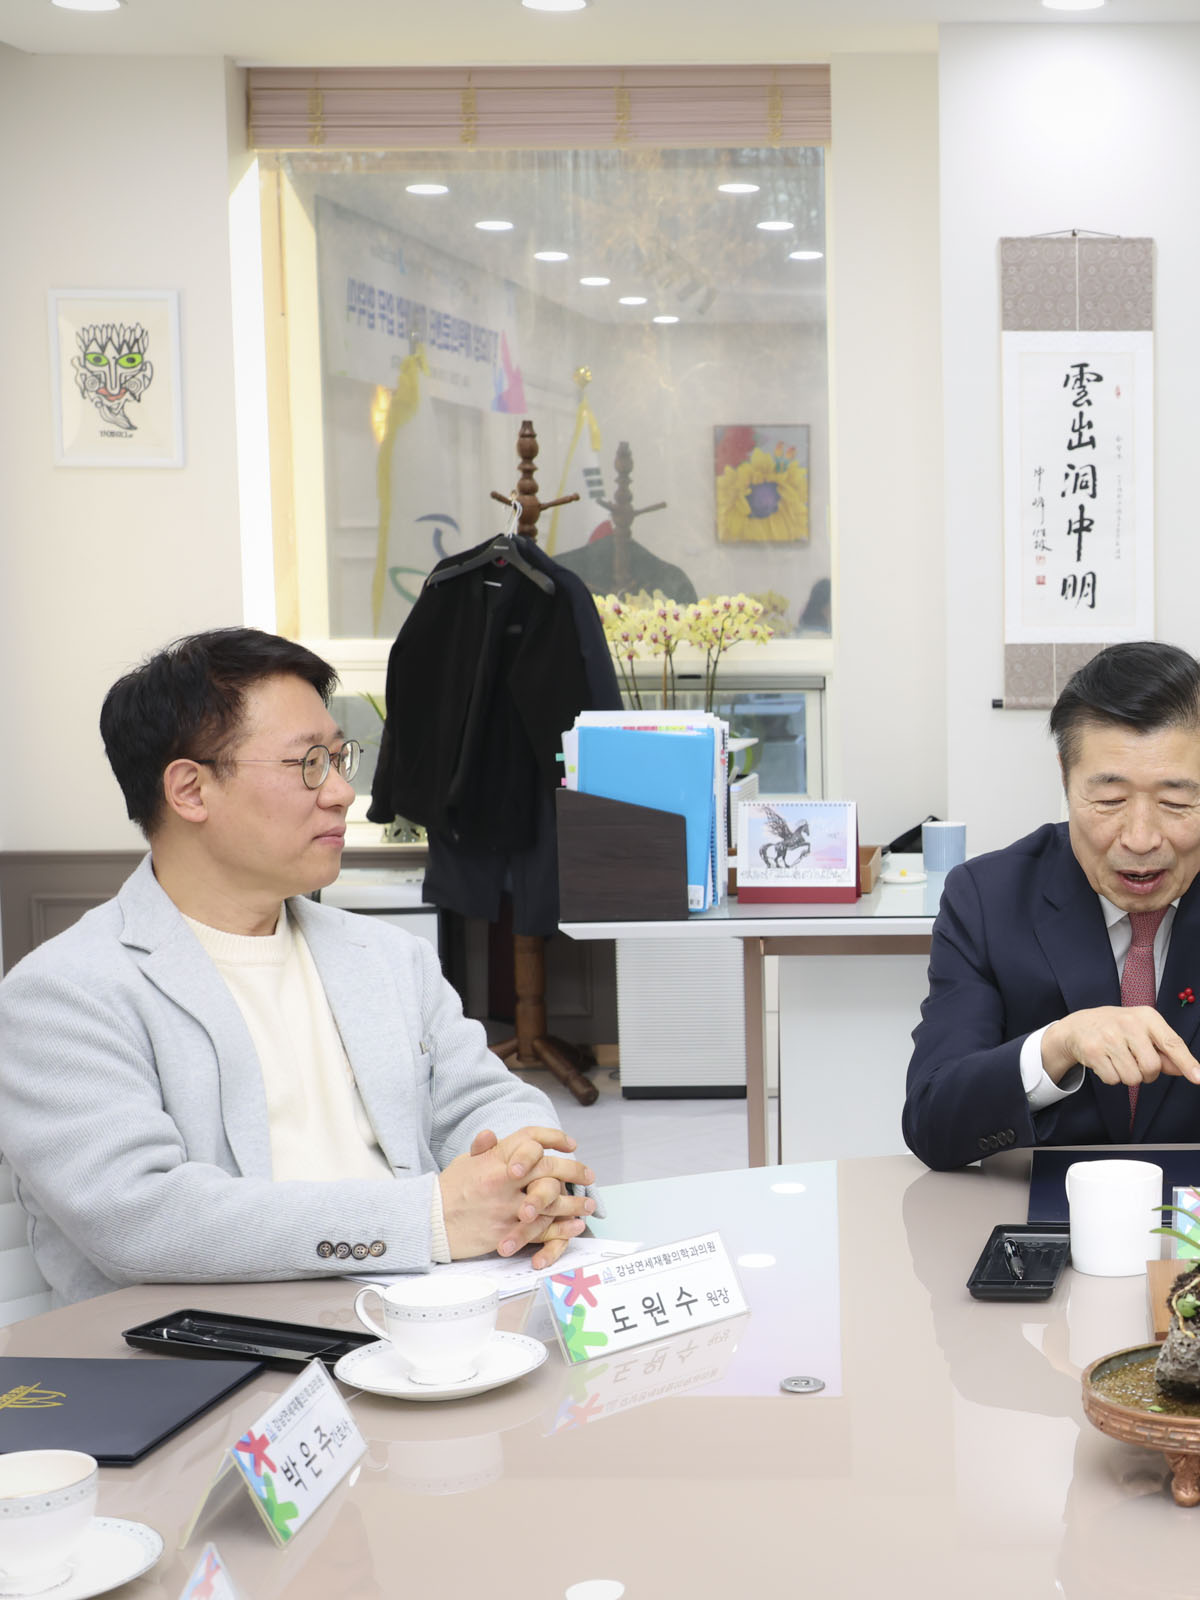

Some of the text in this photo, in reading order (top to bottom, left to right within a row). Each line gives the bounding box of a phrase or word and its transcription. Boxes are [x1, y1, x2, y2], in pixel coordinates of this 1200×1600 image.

[1061, 362, 1104, 609] 雲出洞中明
[615, 1240, 717, 1278] 강남연세재활의학과의원
[705, 1287, 730, 1307] 원장
[330, 1419, 354, 1450] 간호사
